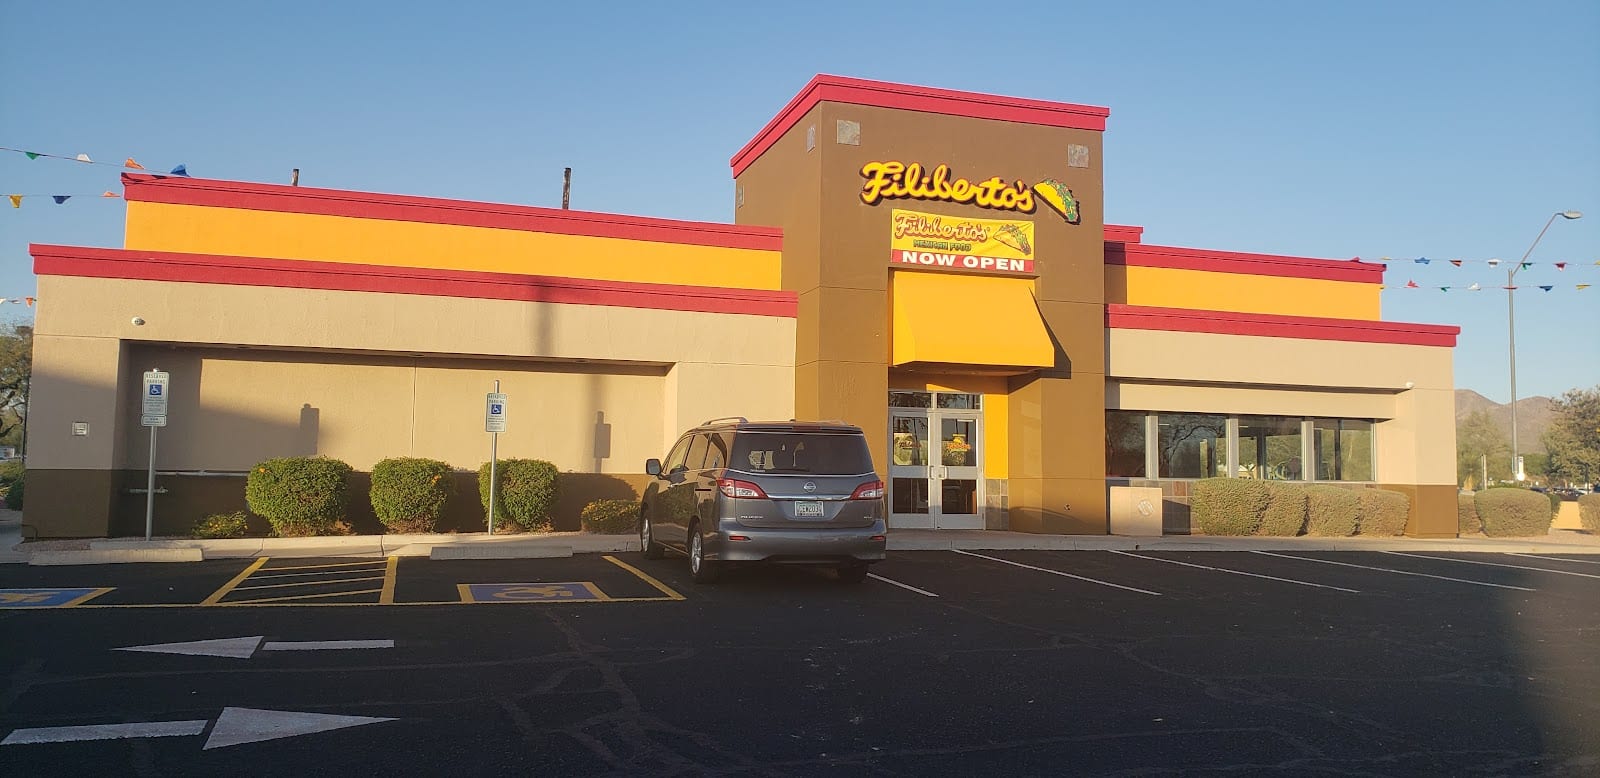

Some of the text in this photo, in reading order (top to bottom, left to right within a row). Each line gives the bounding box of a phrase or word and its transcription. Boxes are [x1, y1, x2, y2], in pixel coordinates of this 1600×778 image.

[861, 160, 1036, 213] Filiberto's
[894, 213, 988, 243] Filiberto's
[913, 239, 972, 252] MEXICAN FOOD
[902, 251, 1025, 272] NOW OPEN
